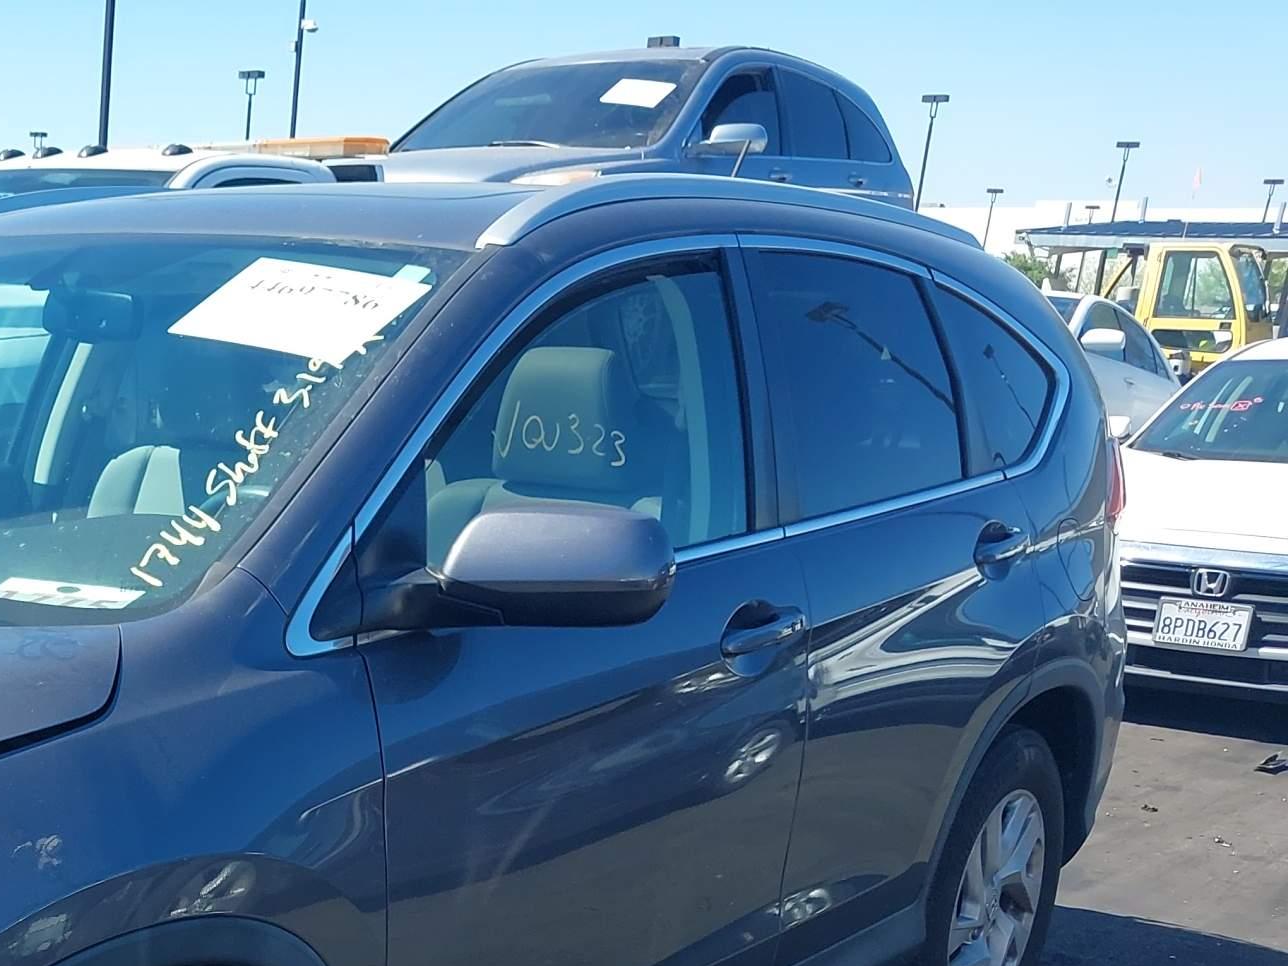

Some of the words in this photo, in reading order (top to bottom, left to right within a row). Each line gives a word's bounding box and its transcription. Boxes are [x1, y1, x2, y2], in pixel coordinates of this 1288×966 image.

[1183, 600, 1230, 611] ANAHEIM
[1160, 615, 1243, 643] 8PDB627
[1157, 635, 1200, 646] HARDIN
[1202, 638, 1238, 650] HONDA
